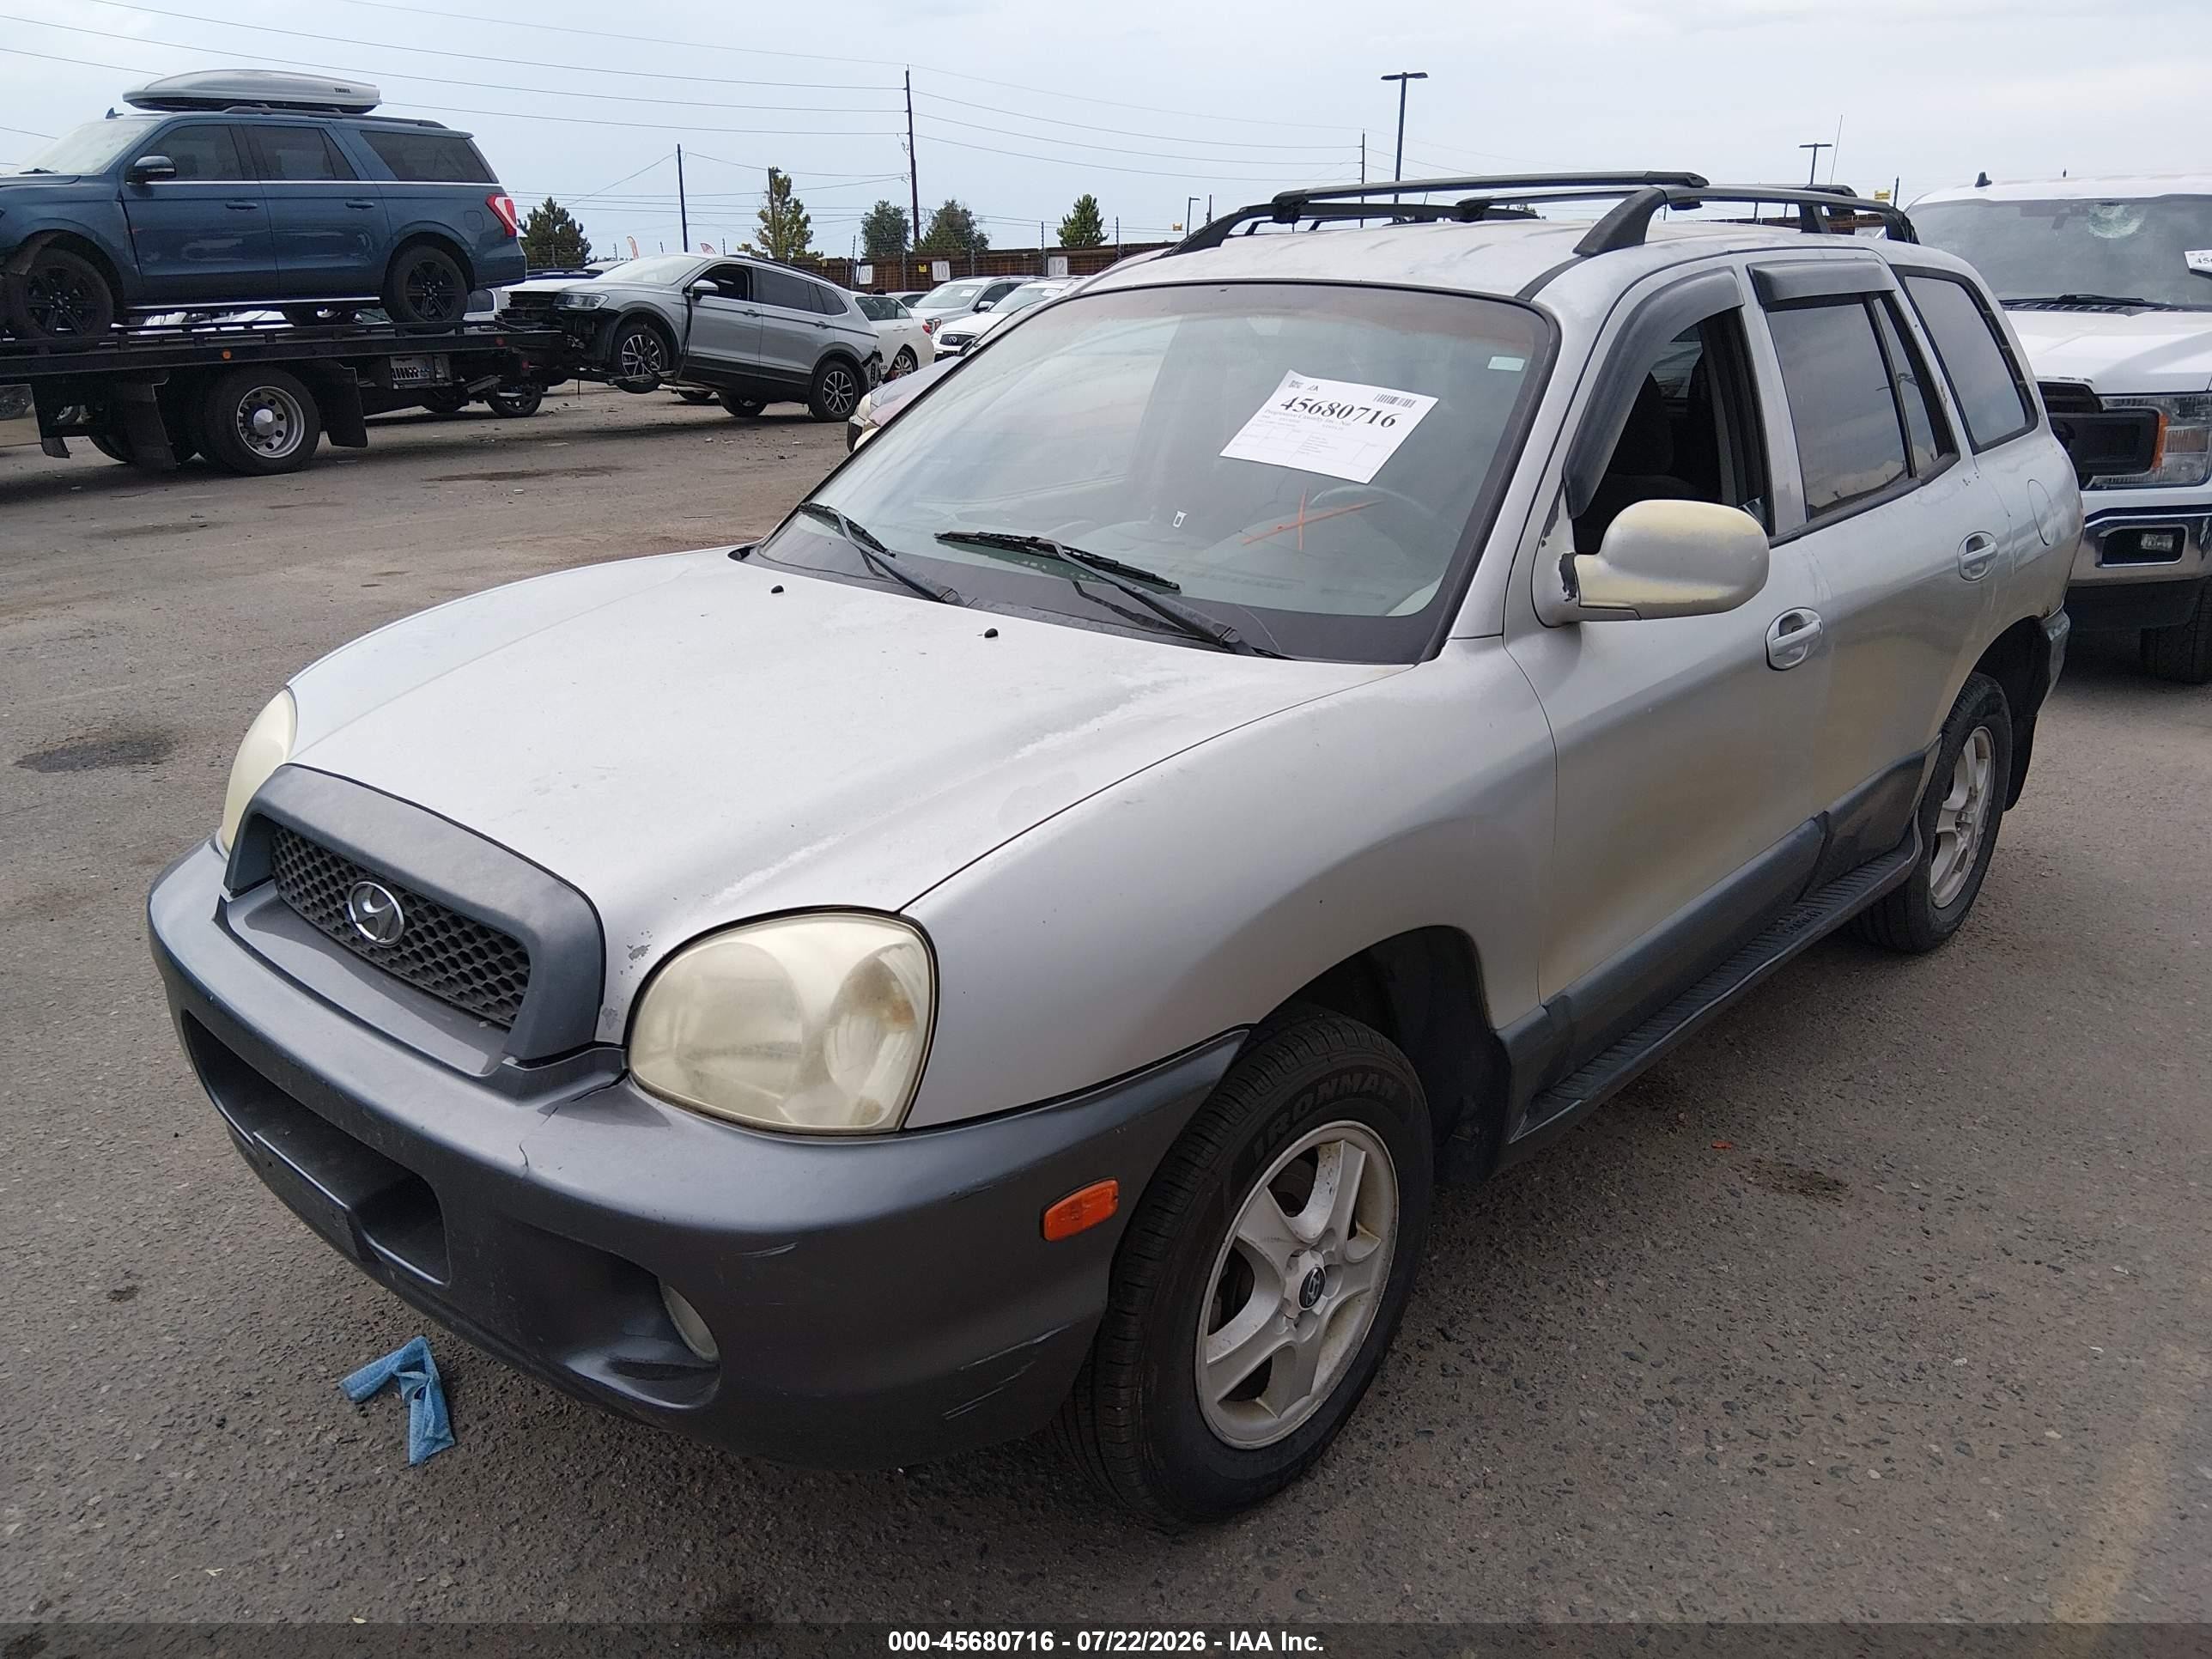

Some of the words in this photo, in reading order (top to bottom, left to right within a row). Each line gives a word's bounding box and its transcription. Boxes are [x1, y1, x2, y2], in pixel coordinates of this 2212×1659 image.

[860, 267, 871, 282] 08
[936, 264, 947, 278] 10
[1052, 259, 1064, 275] 12
[1279, 396, 1402, 428] 45680716
[1251, 1072, 1398, 1162] IRONMAN
